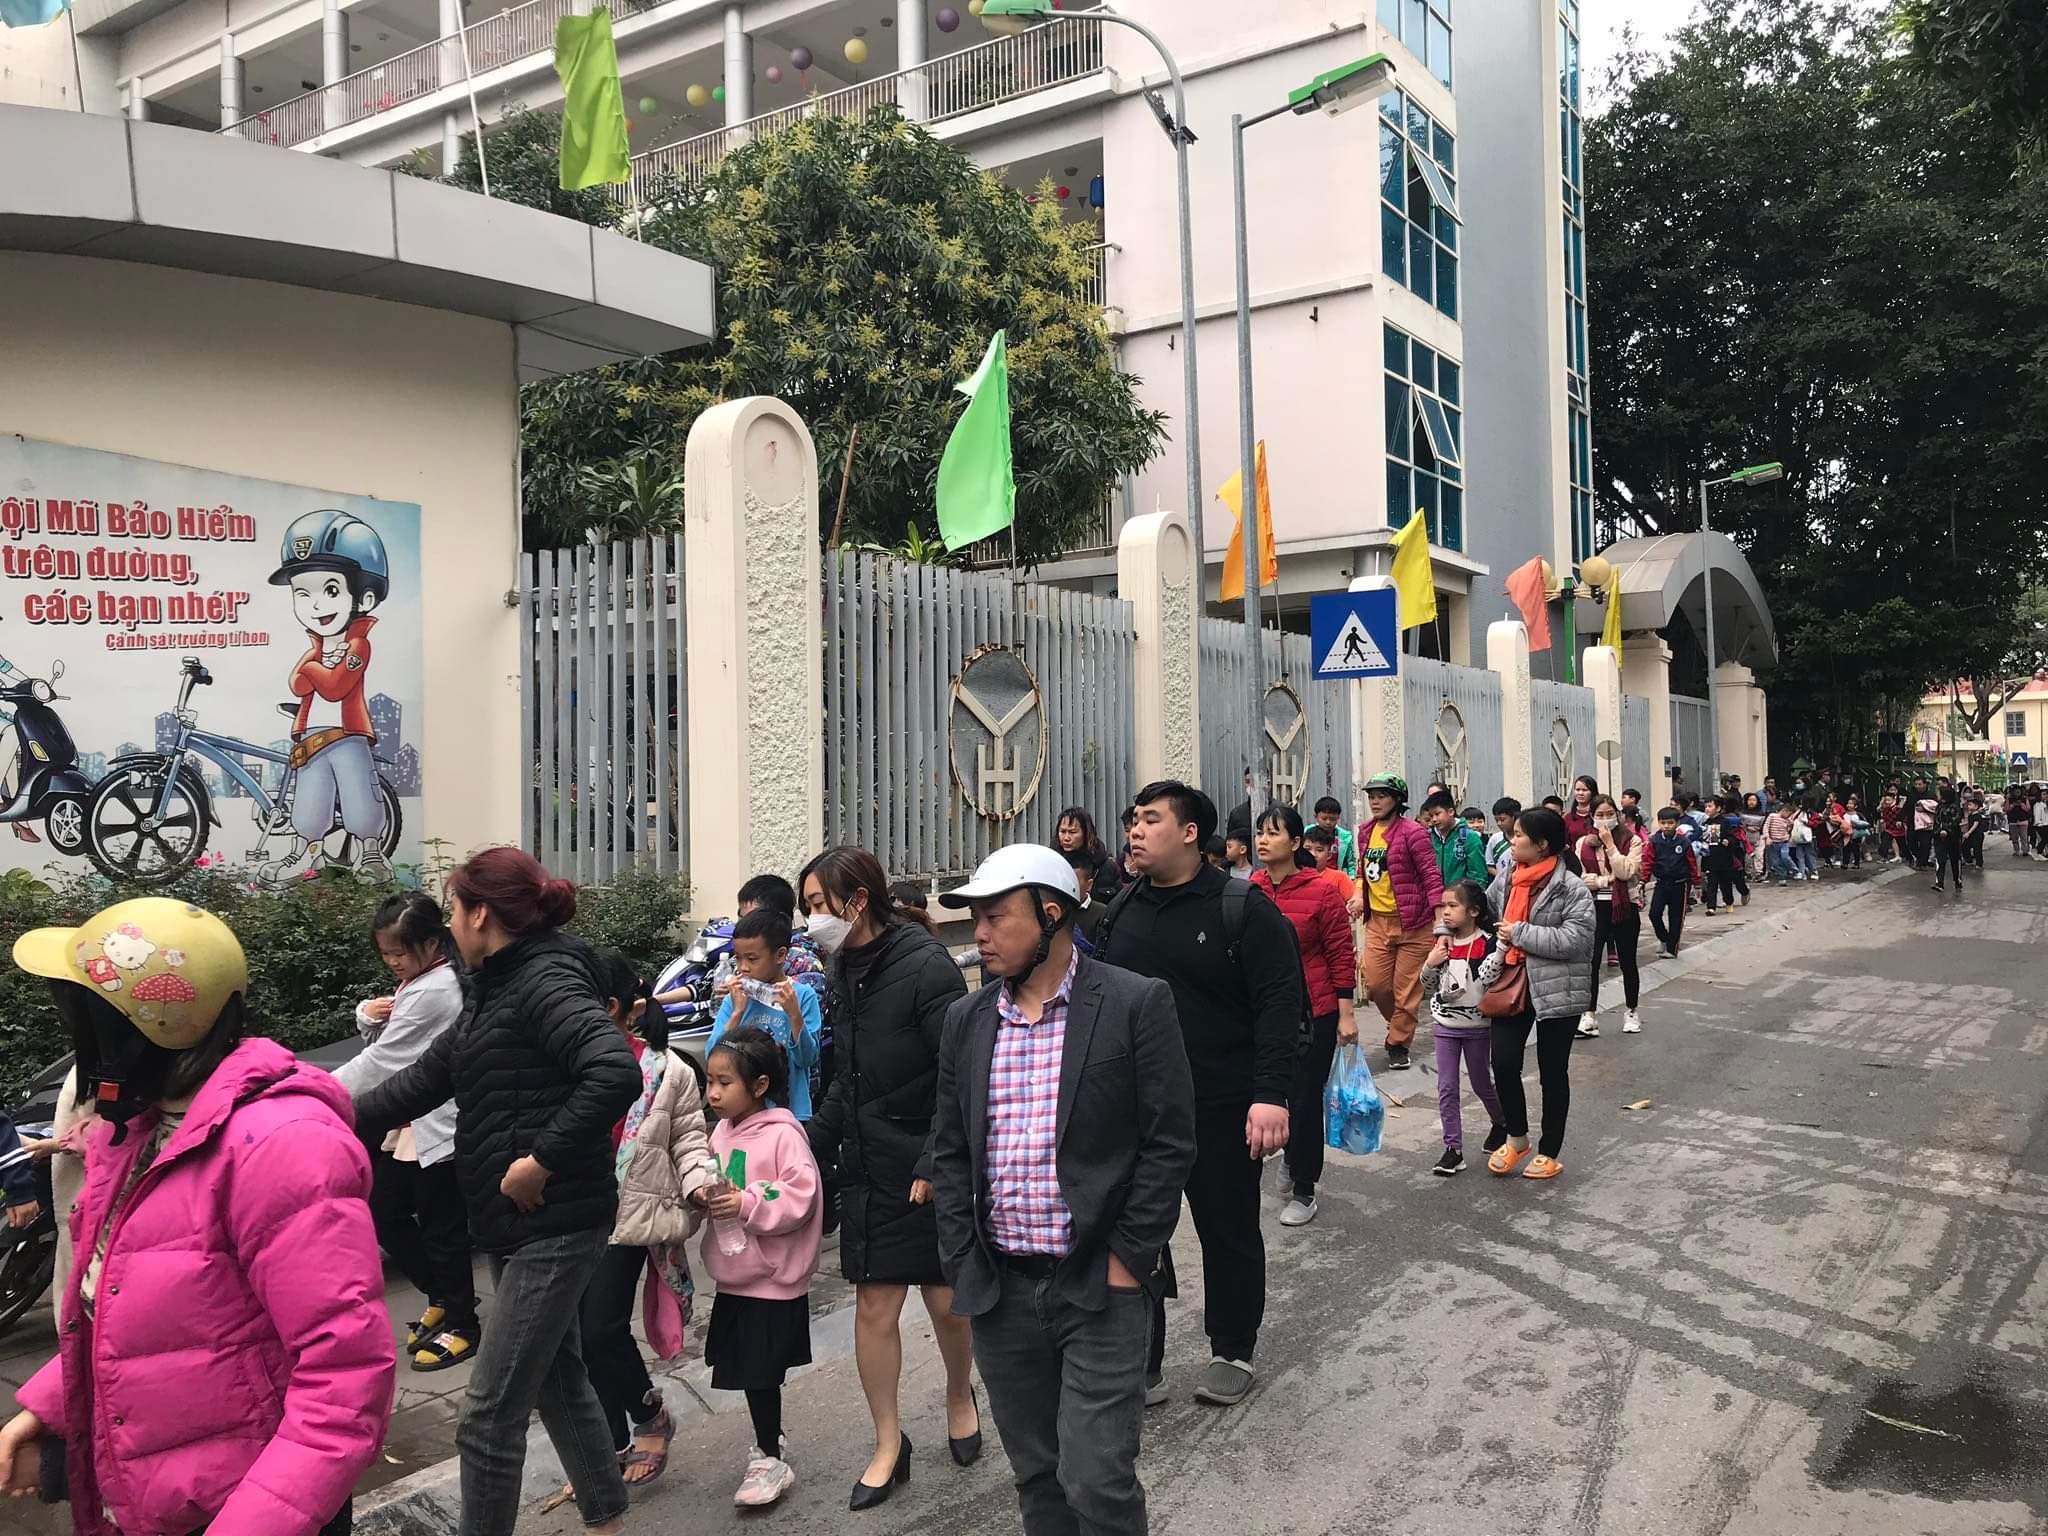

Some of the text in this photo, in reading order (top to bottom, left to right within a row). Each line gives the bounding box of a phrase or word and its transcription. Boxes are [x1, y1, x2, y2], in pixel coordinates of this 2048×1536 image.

[0, 497, 254, 540] ội Mũ Bảo Hiểm
[2, 544, 198, 584] trên đường,
[24, 588, 90, 623] các
[97, 590, 160, 629] bạn
